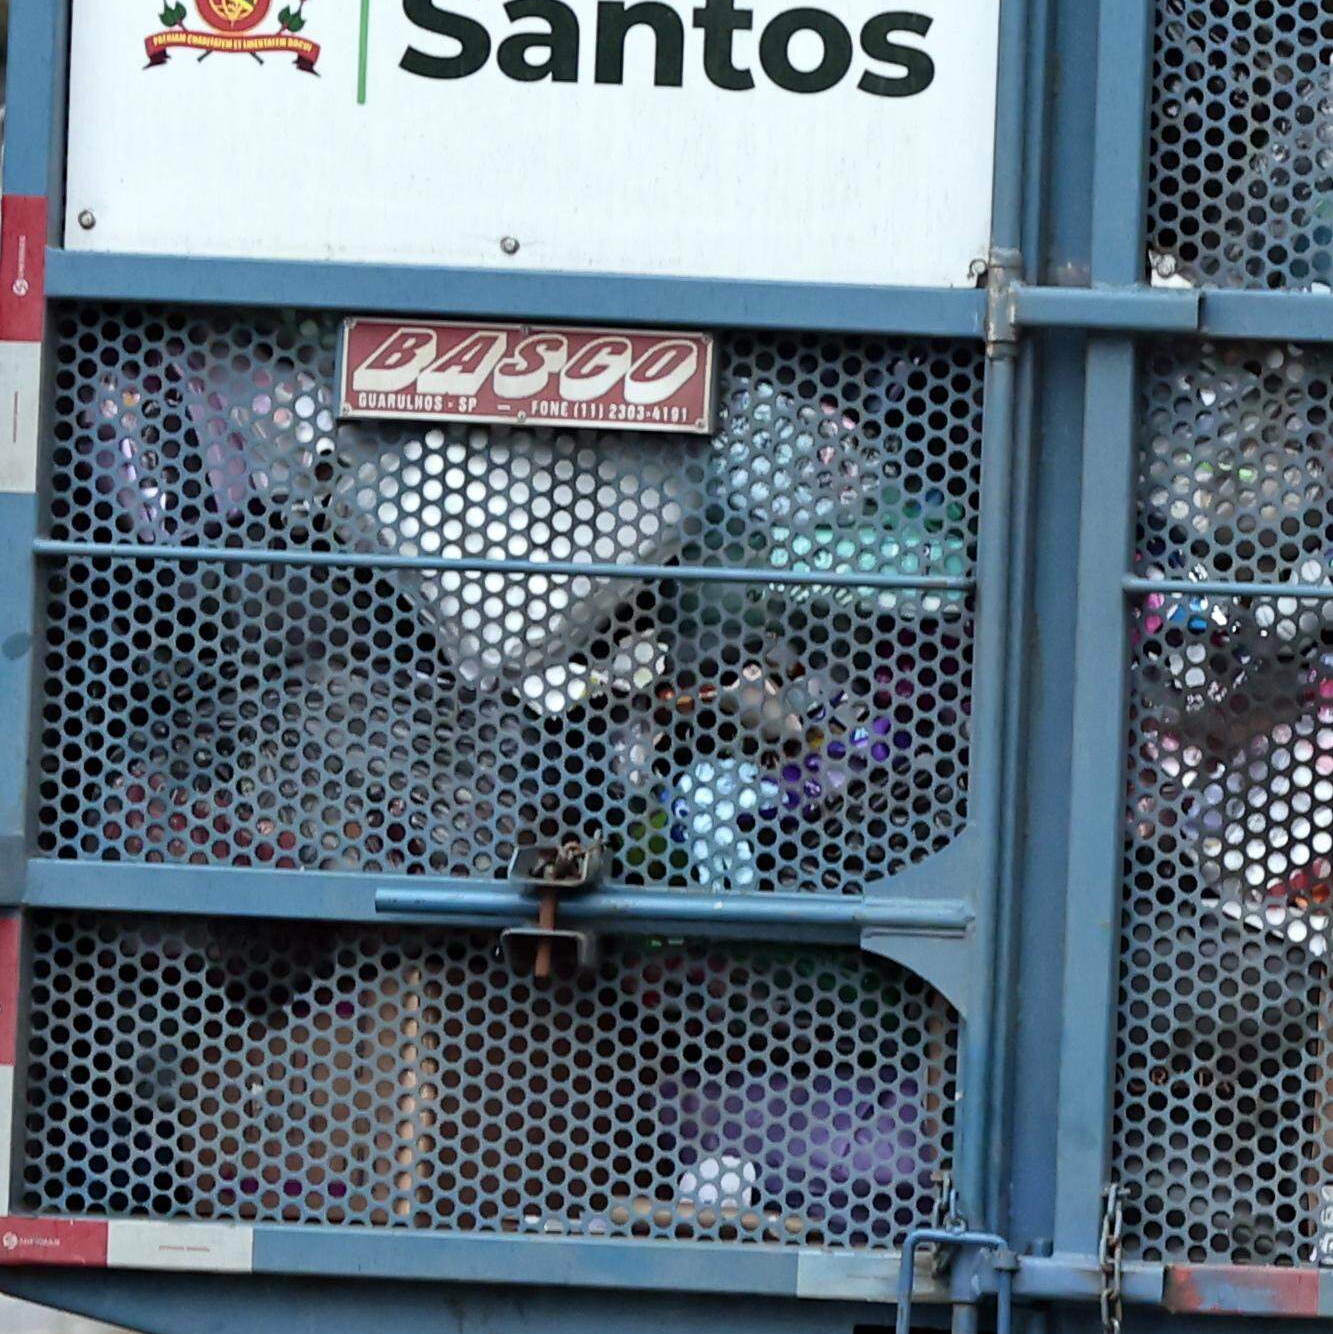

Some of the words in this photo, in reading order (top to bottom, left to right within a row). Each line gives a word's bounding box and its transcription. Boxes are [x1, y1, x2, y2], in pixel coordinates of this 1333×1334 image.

[352, 327, 698, 404] BASCO
[358, 392, 443, 411] GUARULHOS
[458, 397, 478, 412] SP
[531, 400, 568, 417] FONE
[573, 402, 604, 419] (11)
